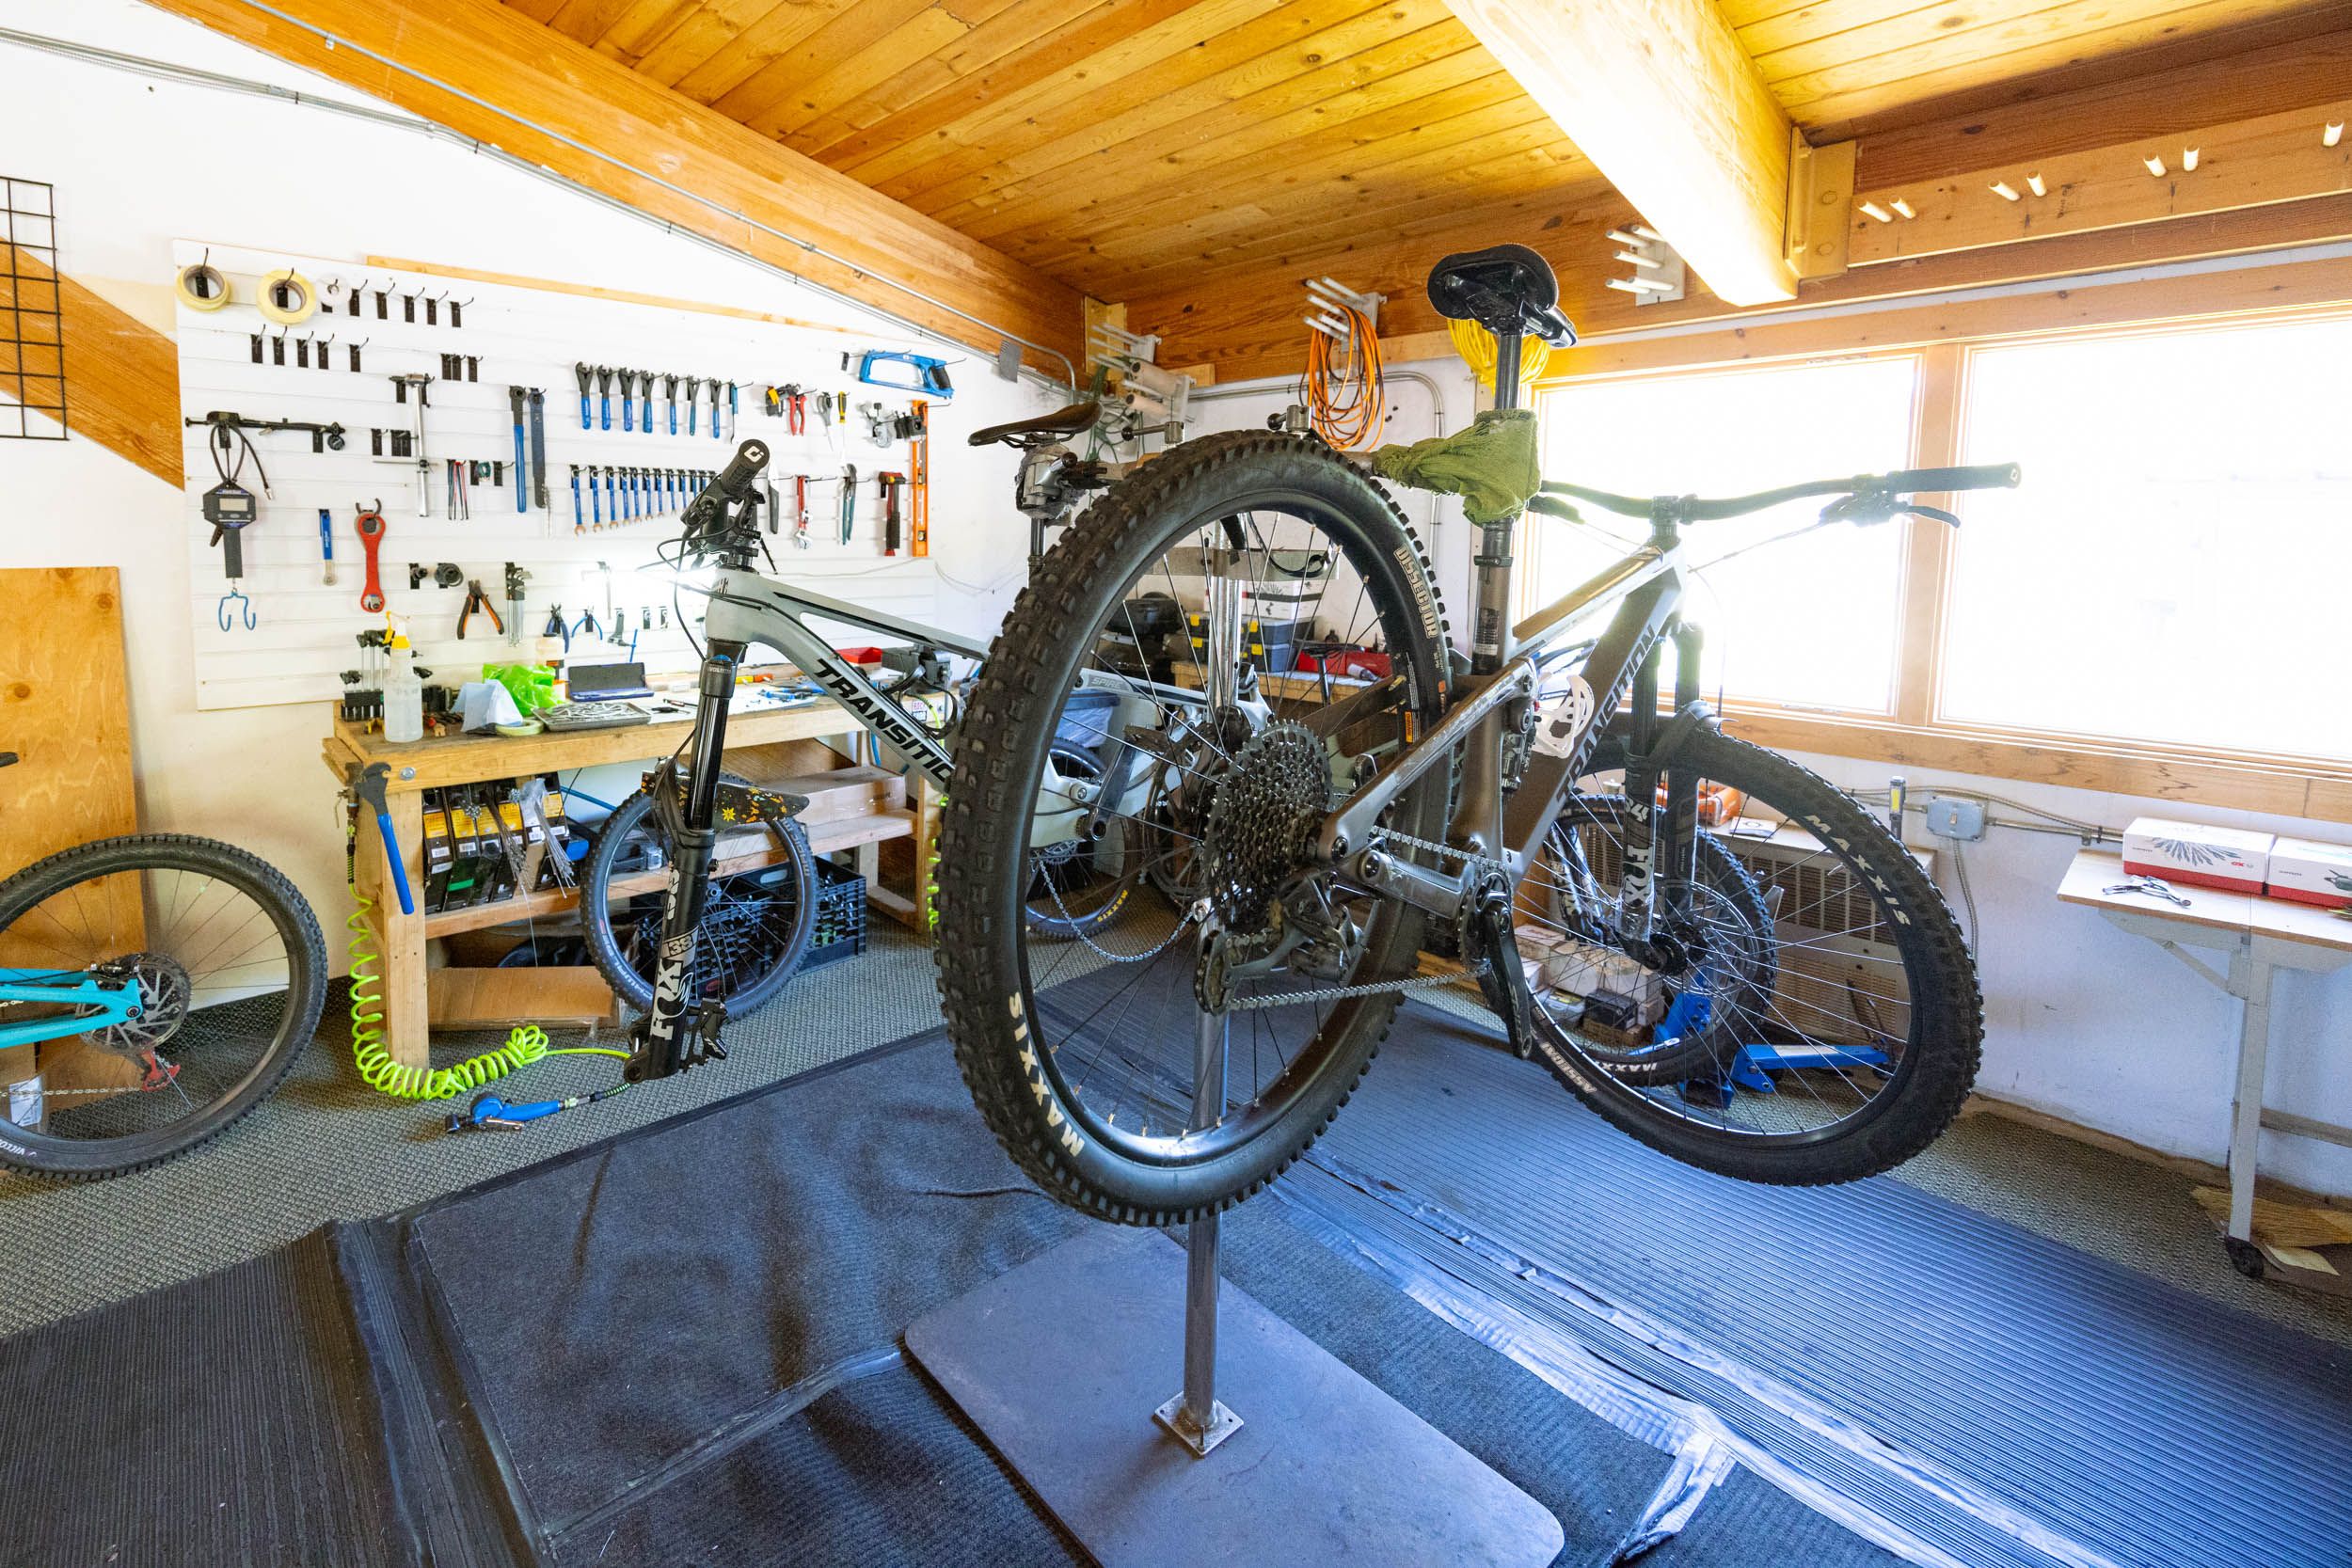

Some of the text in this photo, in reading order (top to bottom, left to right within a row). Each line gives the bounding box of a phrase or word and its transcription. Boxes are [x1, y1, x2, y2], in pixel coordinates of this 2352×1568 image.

[1393, 543, 1438, 640] DISSECTOR
[813, 658, 953, 783] TRANSITIO
[1091, 677, 1123, 688] SPIRE
[1556, 624, 1656, 802] TRANSITION
[1623, 845, 1653, 908] FOX
[1804, 815, 1911, 925] MAXXIS
[602, 935, 653, 1001] CHWALBE
[650, 958, 693, 1040] FOX
[1009, 991, 1085, 1157] MAXXIS
[1596, 1061, 1658, 1072] MAXX
[0, 1139, 25, 1155] VITTO
